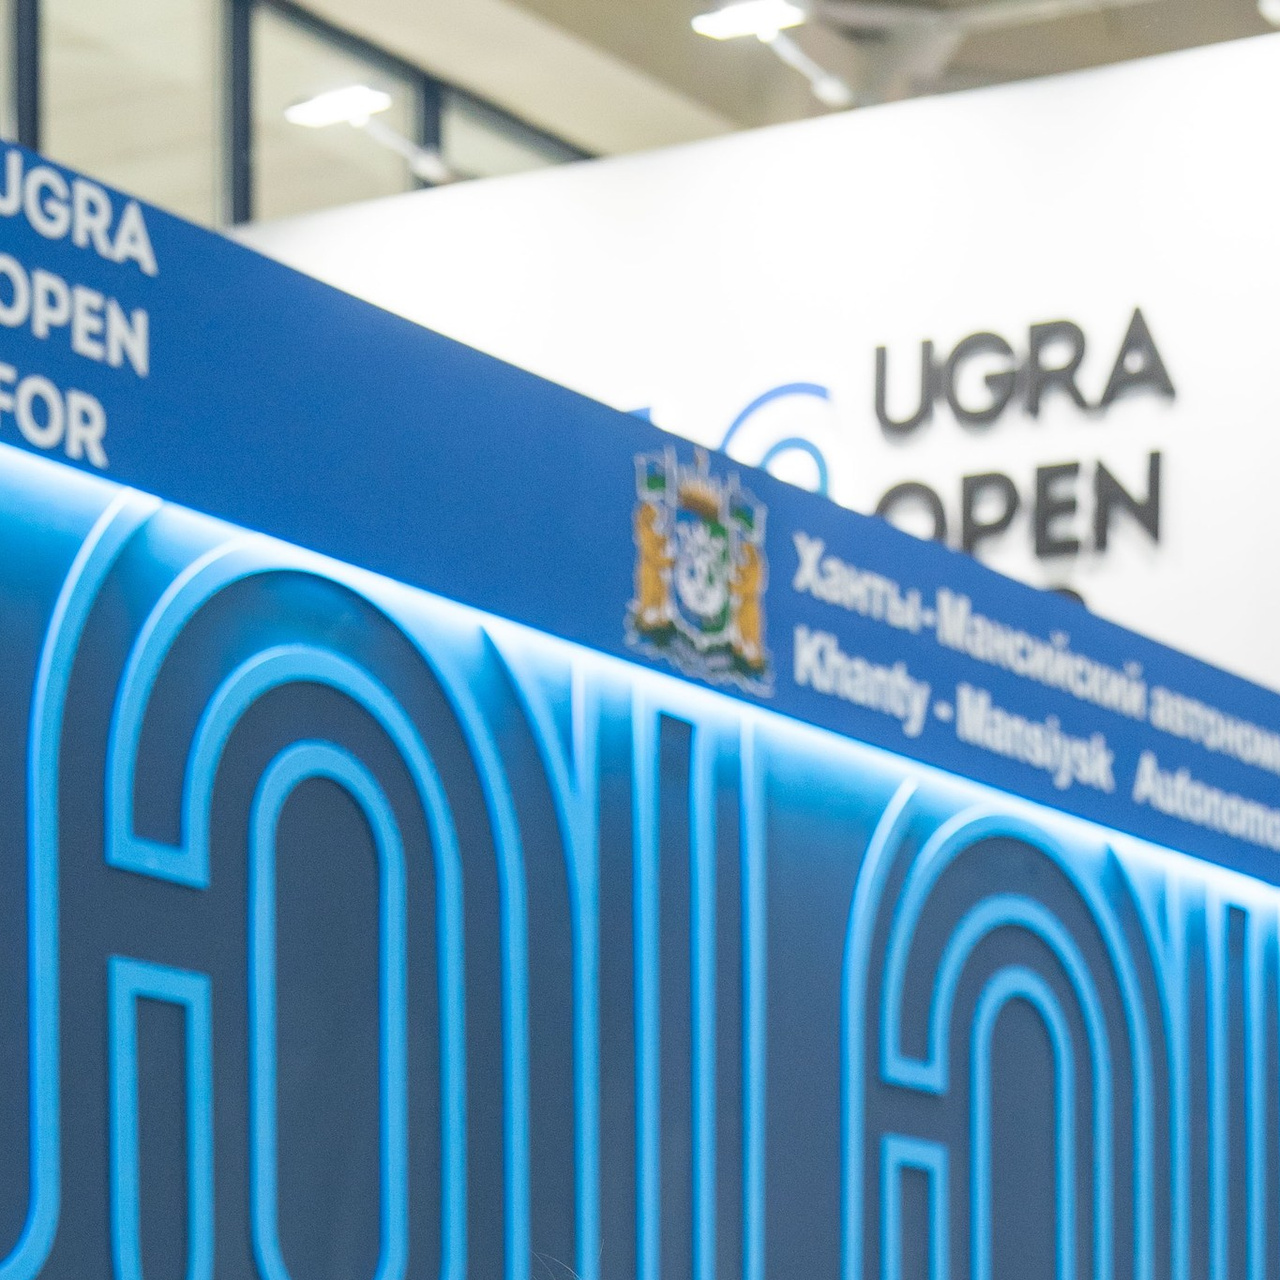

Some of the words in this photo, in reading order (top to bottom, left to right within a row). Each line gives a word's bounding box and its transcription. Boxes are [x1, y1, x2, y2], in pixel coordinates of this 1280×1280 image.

[0, 253, 149, 379] OPEN
[875, 307, 1176, 435] UGRA
[794, 624, 931, 738] Khanty
[956, 682, 1116, 793] Mansiysk
